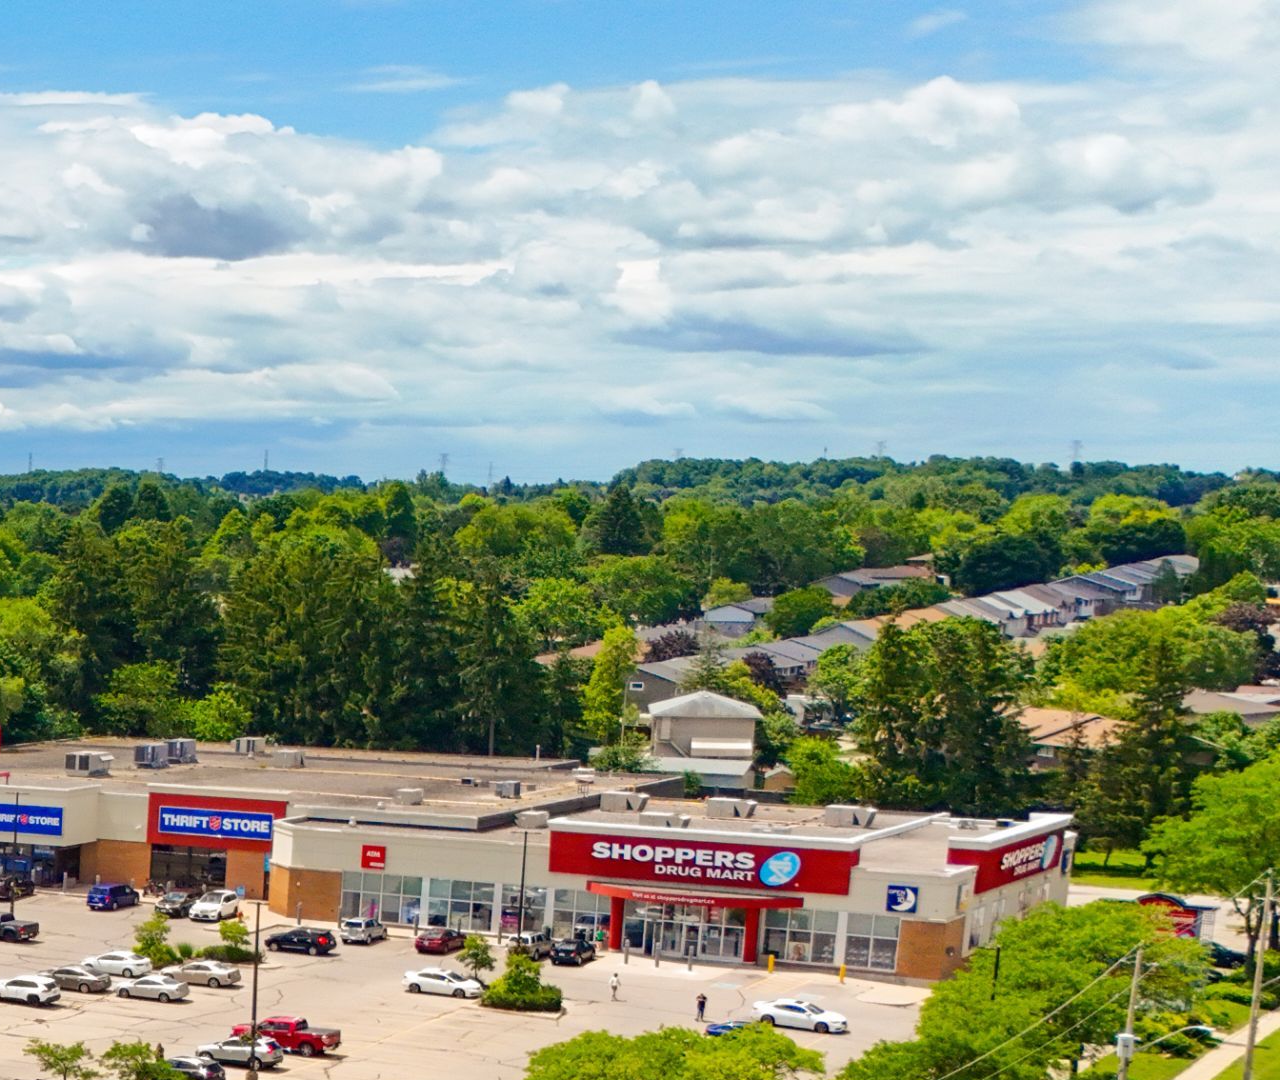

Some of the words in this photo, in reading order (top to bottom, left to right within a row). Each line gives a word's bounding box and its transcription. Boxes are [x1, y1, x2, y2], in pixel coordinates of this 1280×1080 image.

[29, 815, 60, 826] STORE
[162, 813, 208, 829] THRIFT
[222, 818, 270, 833] STORE
[591, 841, 756, 870] SHOPPERS
[1000, 841, 1046, 870] SHOPPERS
[654, 864, 702, 878] DRUG
[706, 867, 755, 881] MART
